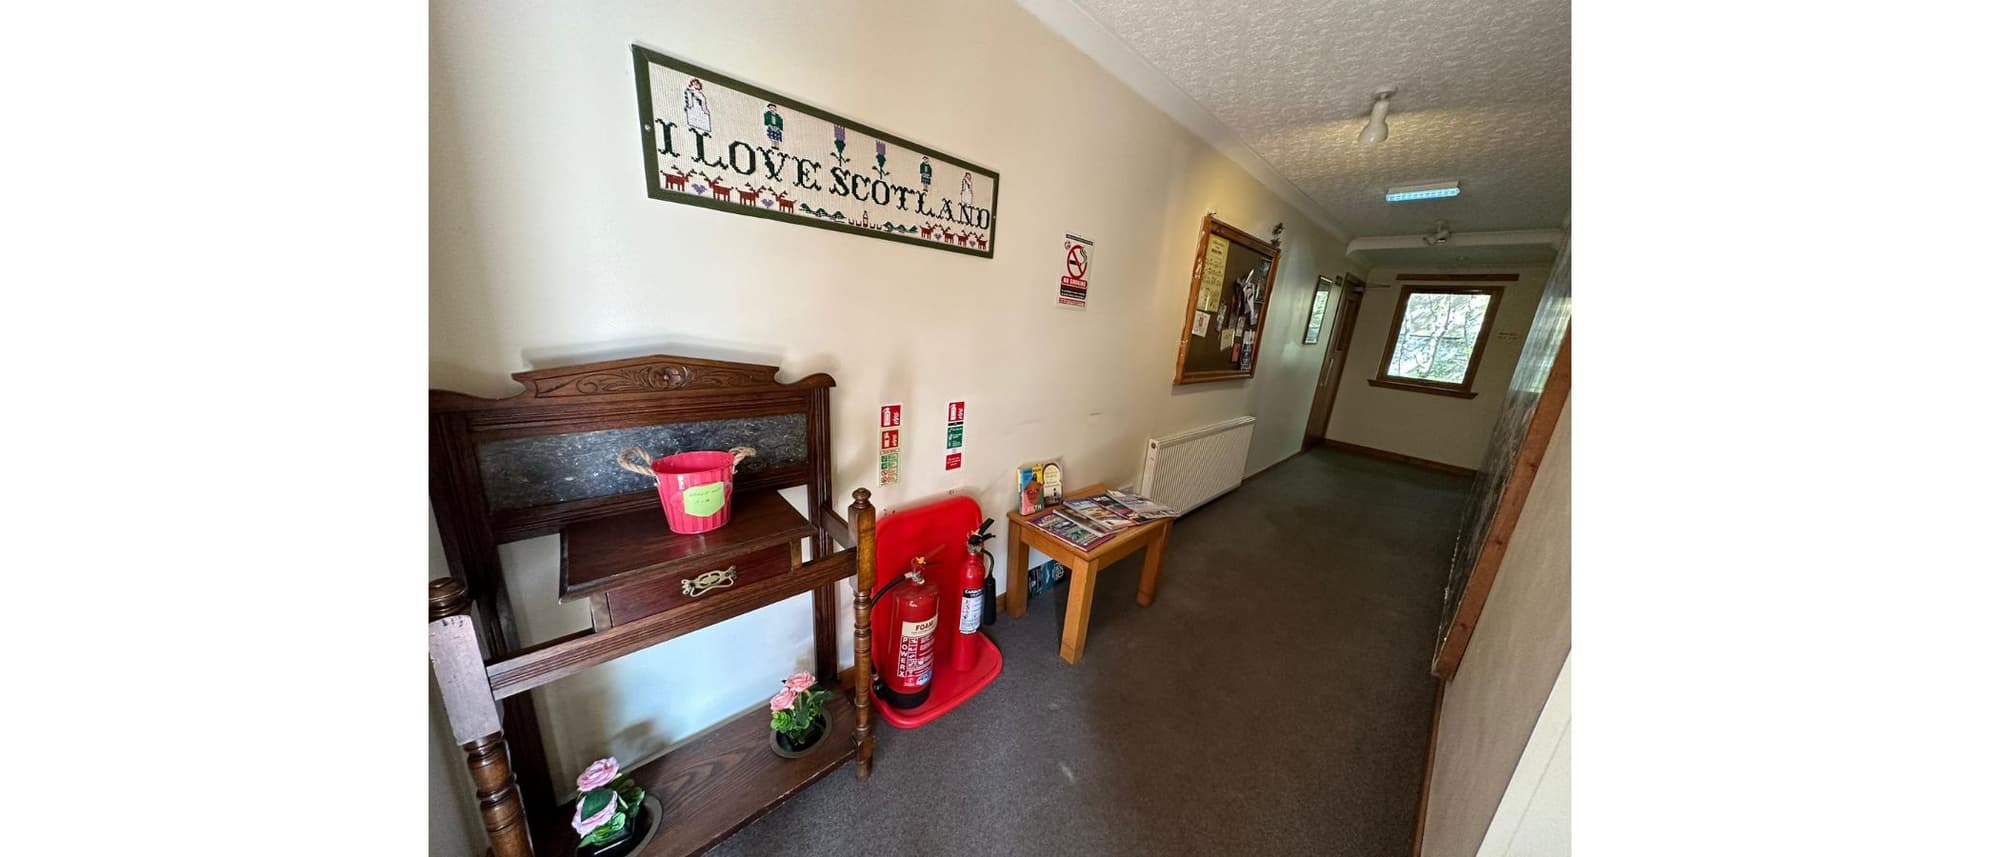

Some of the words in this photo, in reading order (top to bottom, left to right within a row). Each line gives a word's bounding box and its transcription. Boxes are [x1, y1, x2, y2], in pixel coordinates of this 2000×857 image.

[655, 118, 680, 158] I
[688, 127, 822, 193] LOVE
[828, 165, 991, 230] SCOTLAND
[915, 620, 935, 631] FOAM
